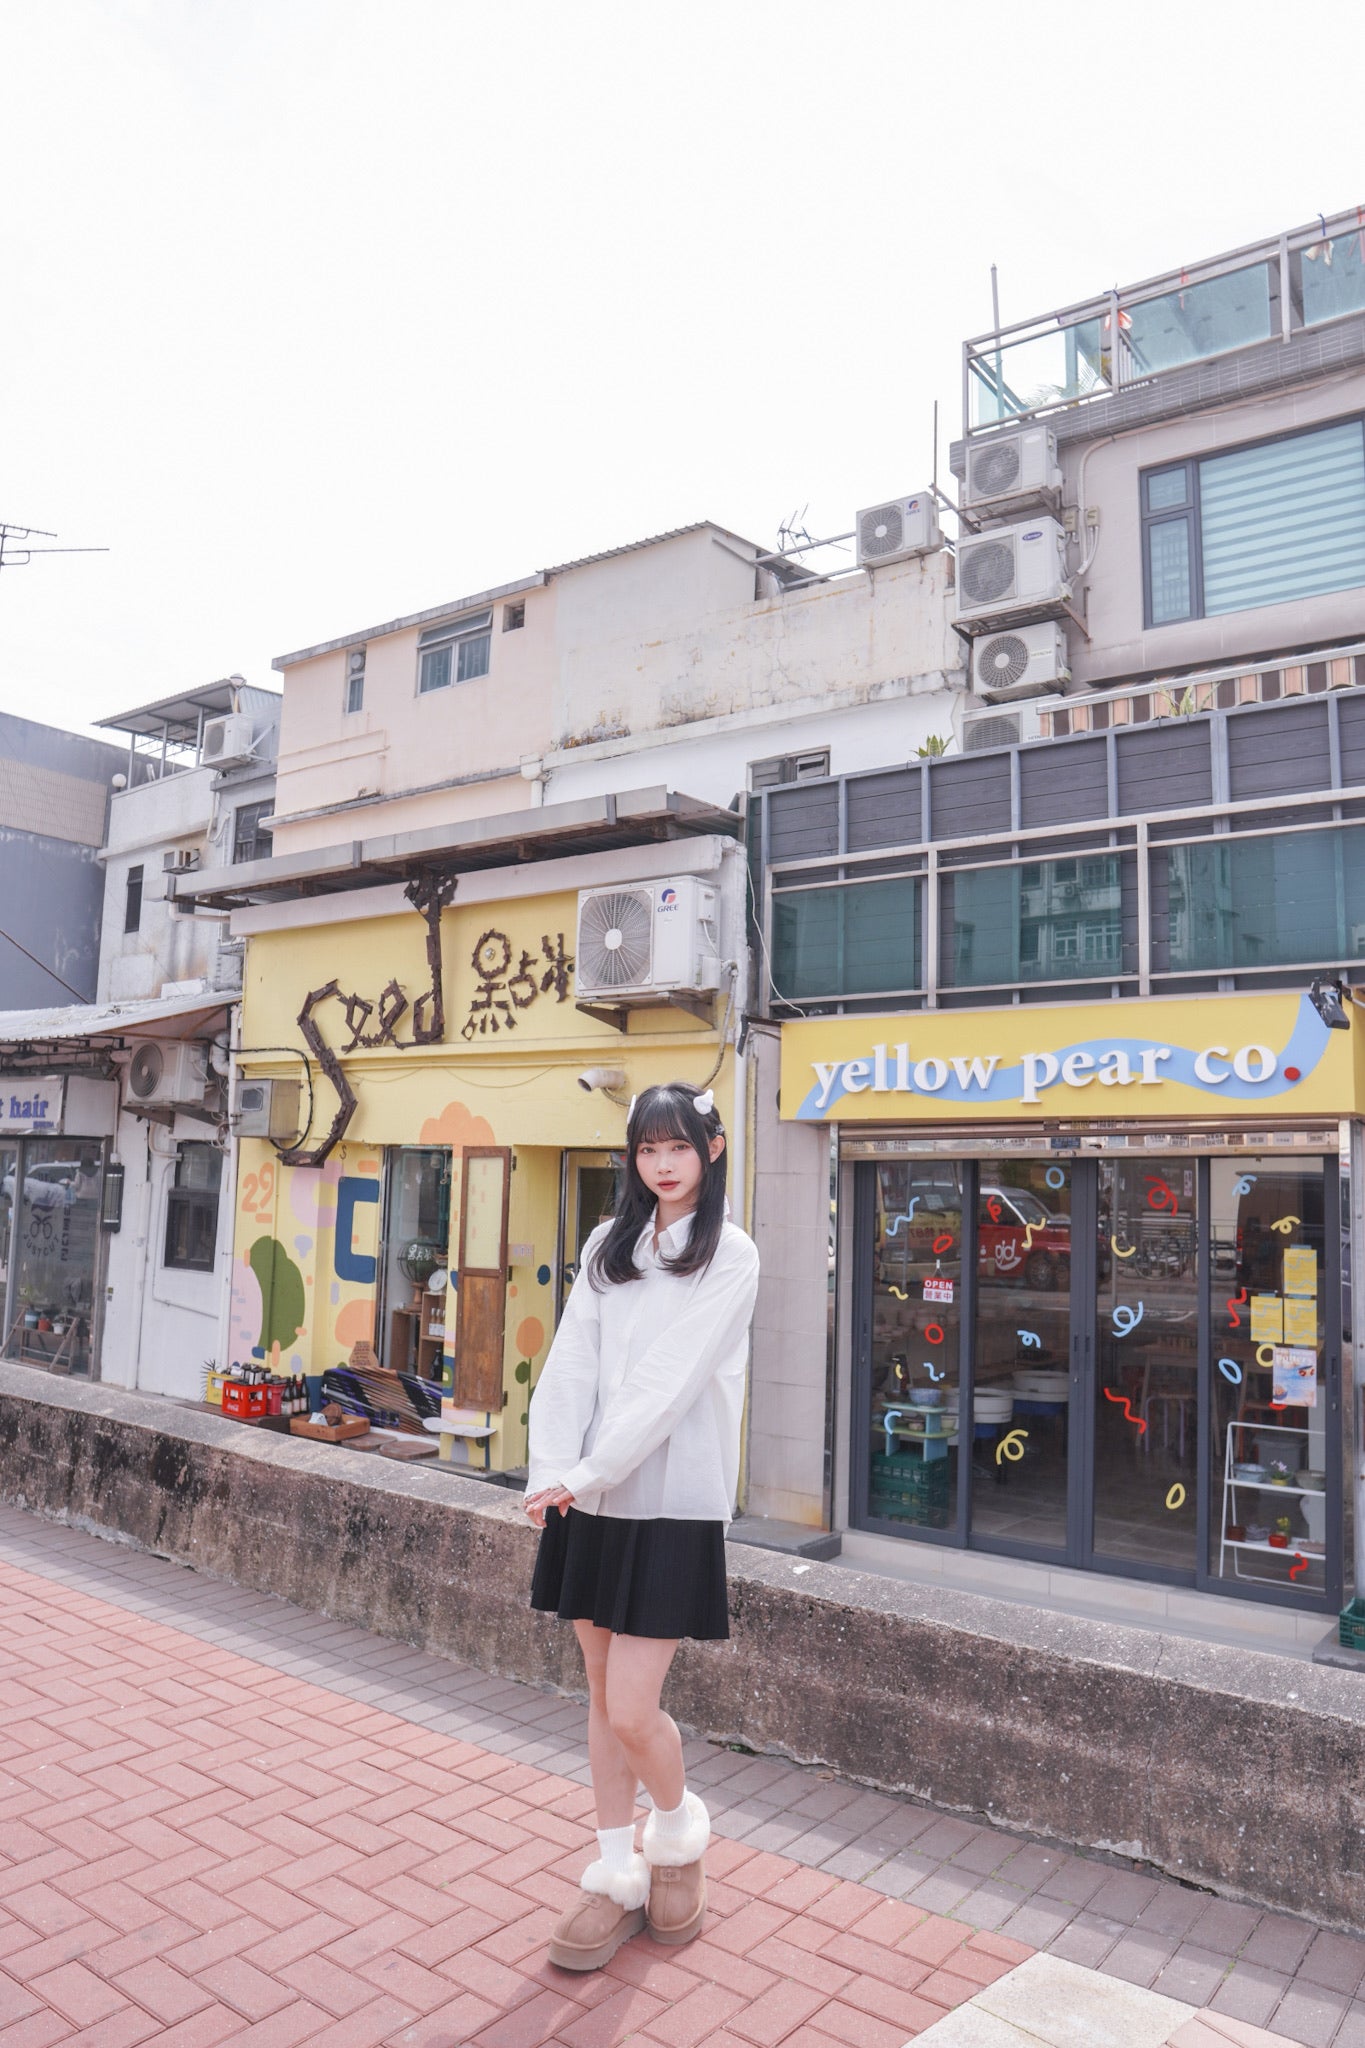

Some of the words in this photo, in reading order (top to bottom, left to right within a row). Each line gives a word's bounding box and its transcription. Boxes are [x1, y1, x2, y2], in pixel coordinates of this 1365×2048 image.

[657, 904, 679, 913] GREE
[811, 1043, 1002, 1109] yellow
[1020, 1046, 1171, 1104] pear
[1193, 1044, 1301, 1085] co.
[9, 1093, 49, 1118] hair
[241, 1162, 274, 1212] 29
[924, 1280, 953, 1290] OPEN
